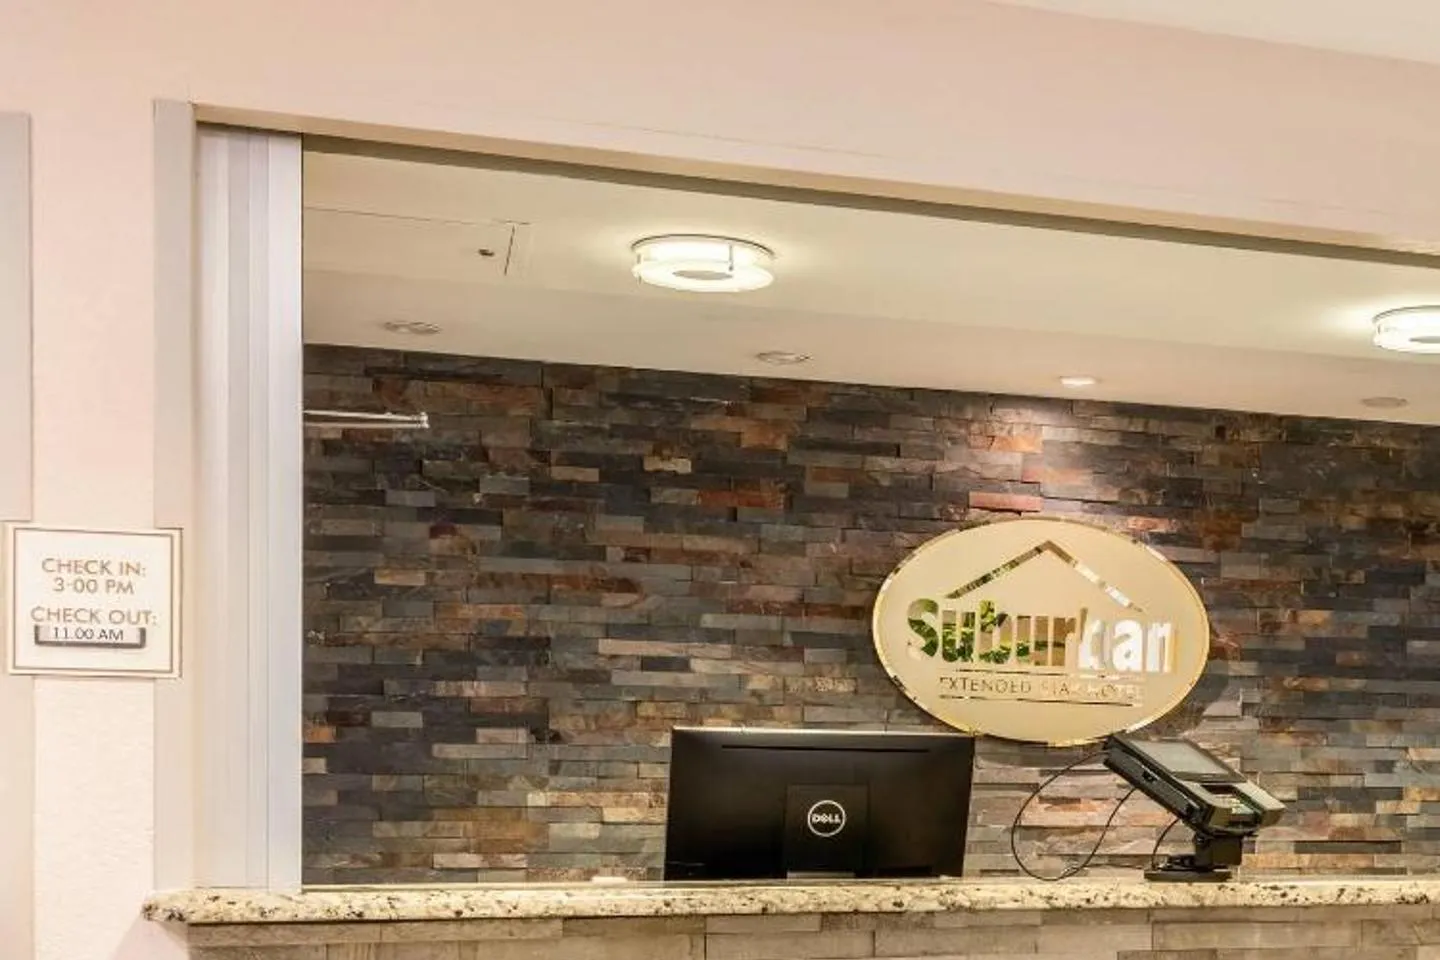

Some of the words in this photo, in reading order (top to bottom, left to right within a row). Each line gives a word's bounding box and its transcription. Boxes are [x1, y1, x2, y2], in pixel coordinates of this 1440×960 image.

[42, 558, 112, 575] CHECK
[119, 562, 147, 576] IN:
[105, 579, 135, 594] PM
[30, 606, 101, 623] CHECK
[108, 609, 157, 626] OUT:
[99, 629, 124, 640] AM
[906, 598, 1175, 673] Suburban
[939, 676, 1031, 694] EXTENDED
[811, 812, 841, 824] DELL
